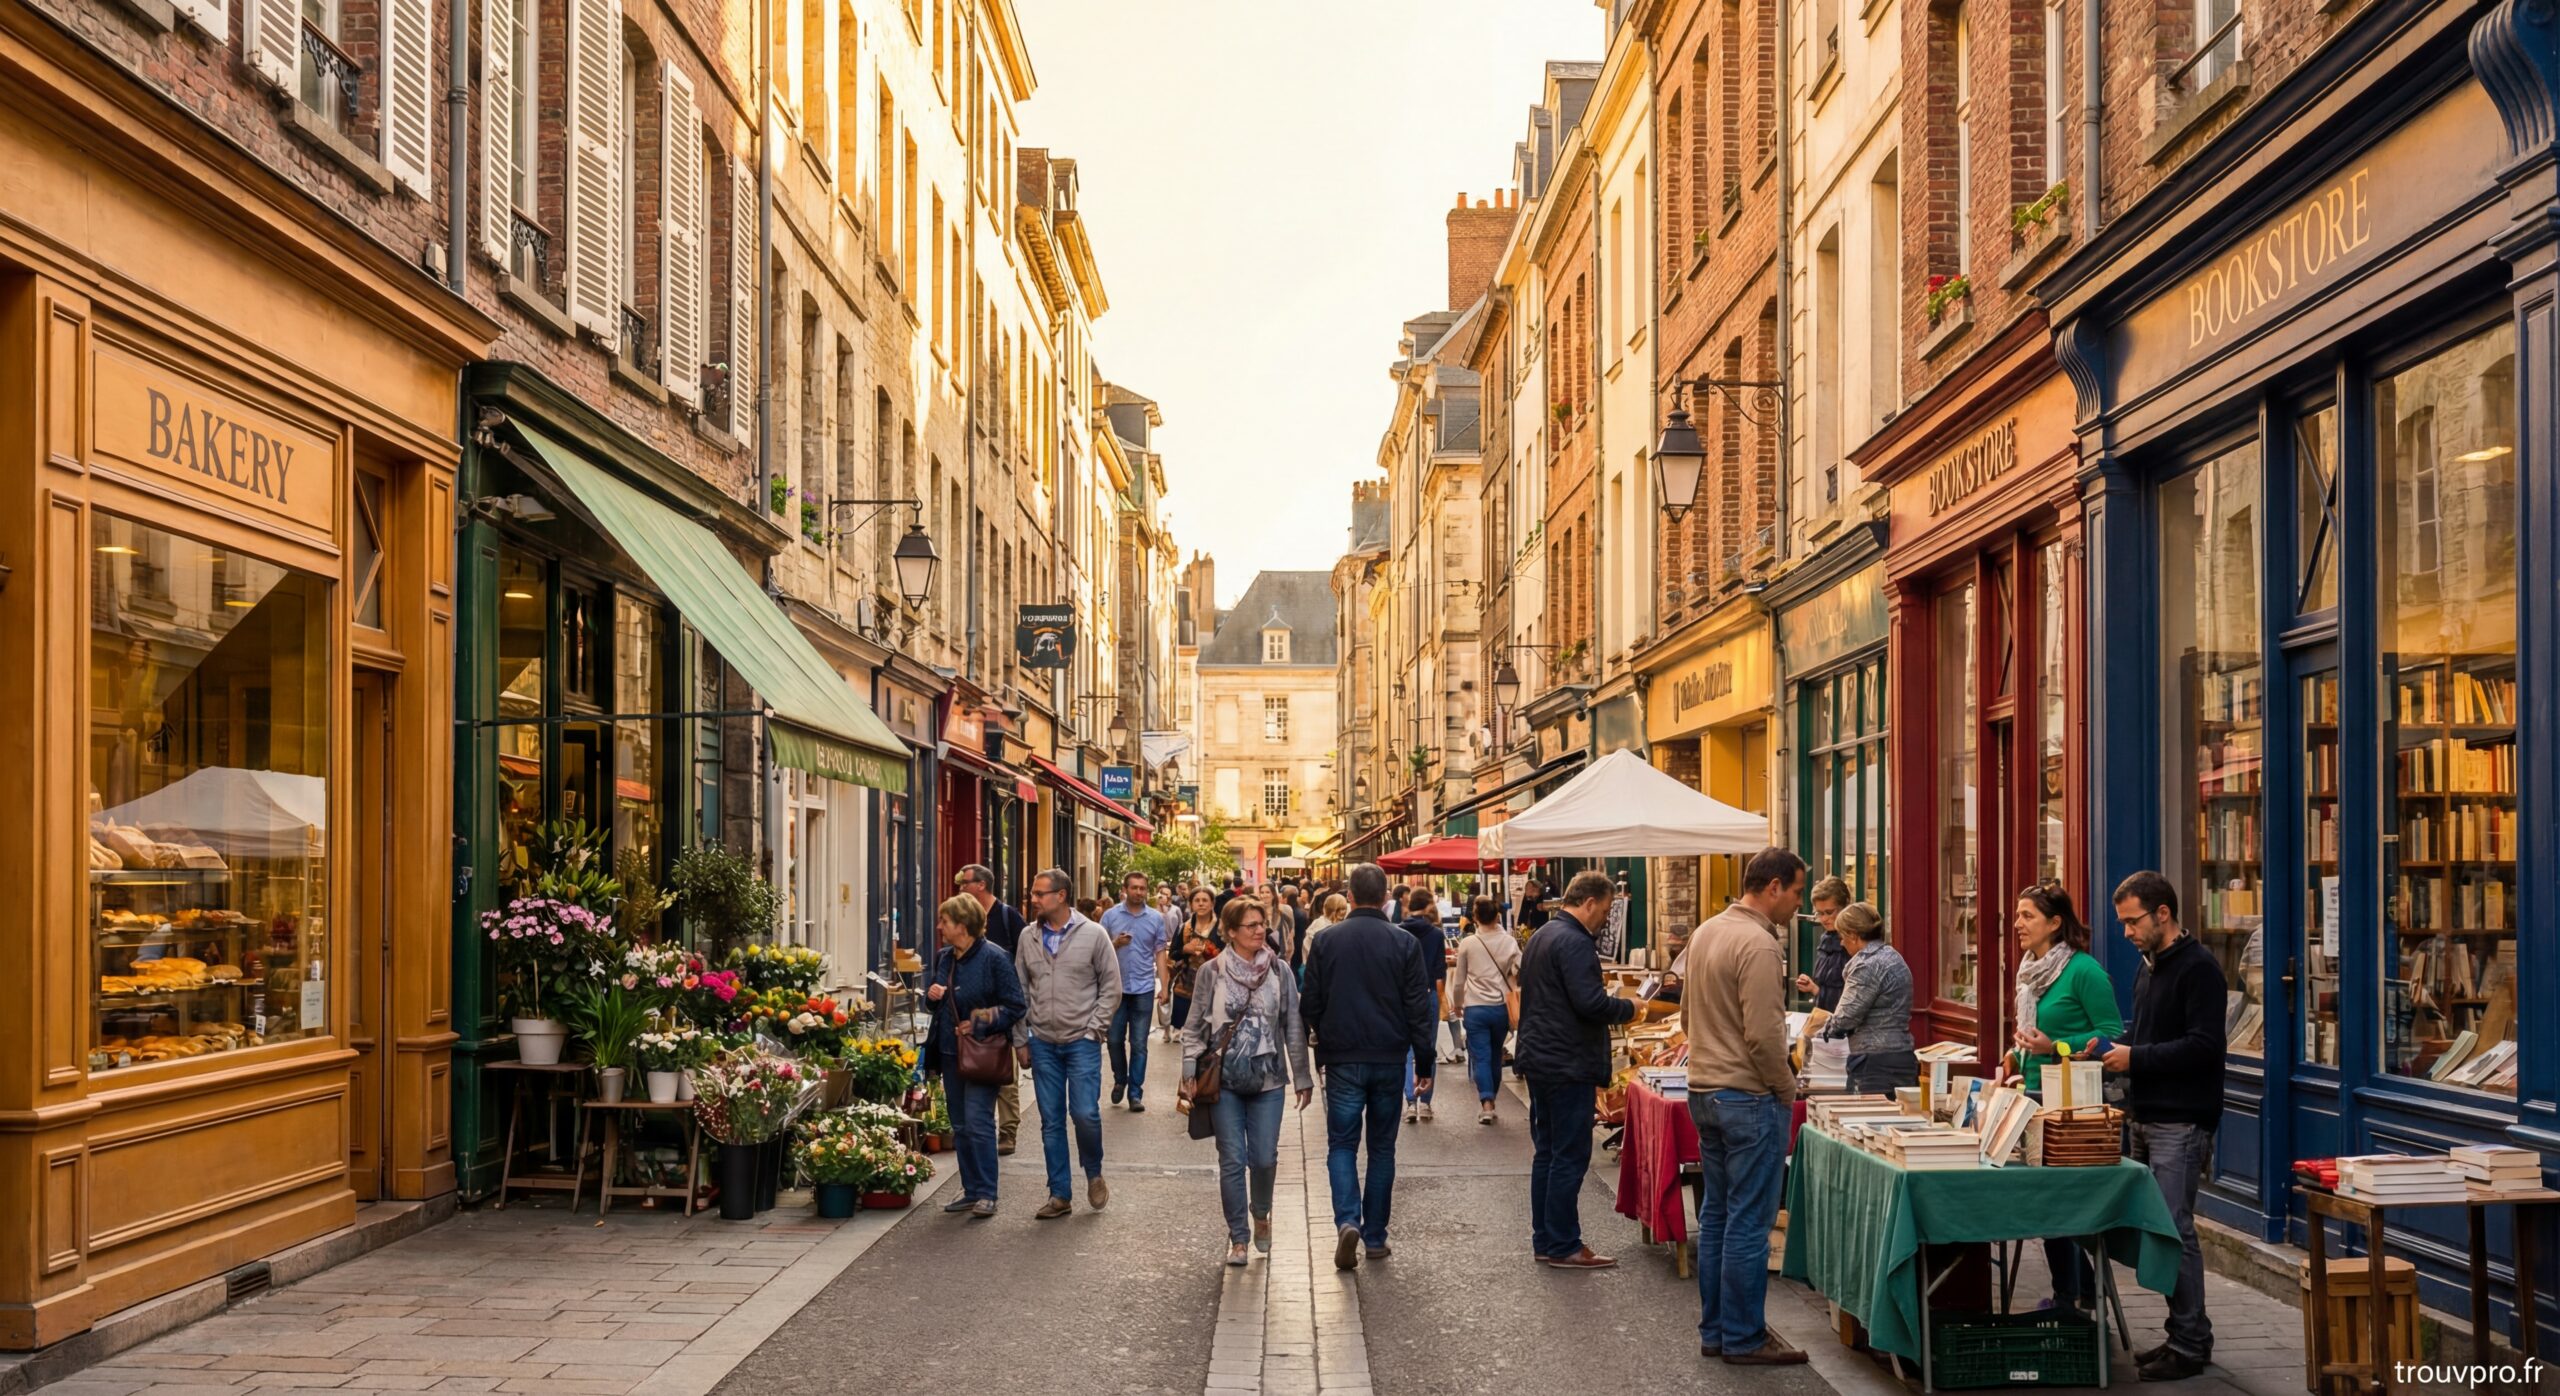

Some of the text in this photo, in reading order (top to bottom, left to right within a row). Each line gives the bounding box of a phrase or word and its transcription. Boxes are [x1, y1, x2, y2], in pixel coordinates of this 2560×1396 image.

[2188, 167, 2371, 350] BOOKSTORE
[146, 387, 294, 505] BAKERY
[1928, 417, 2017, 517] BOOKSTORE
